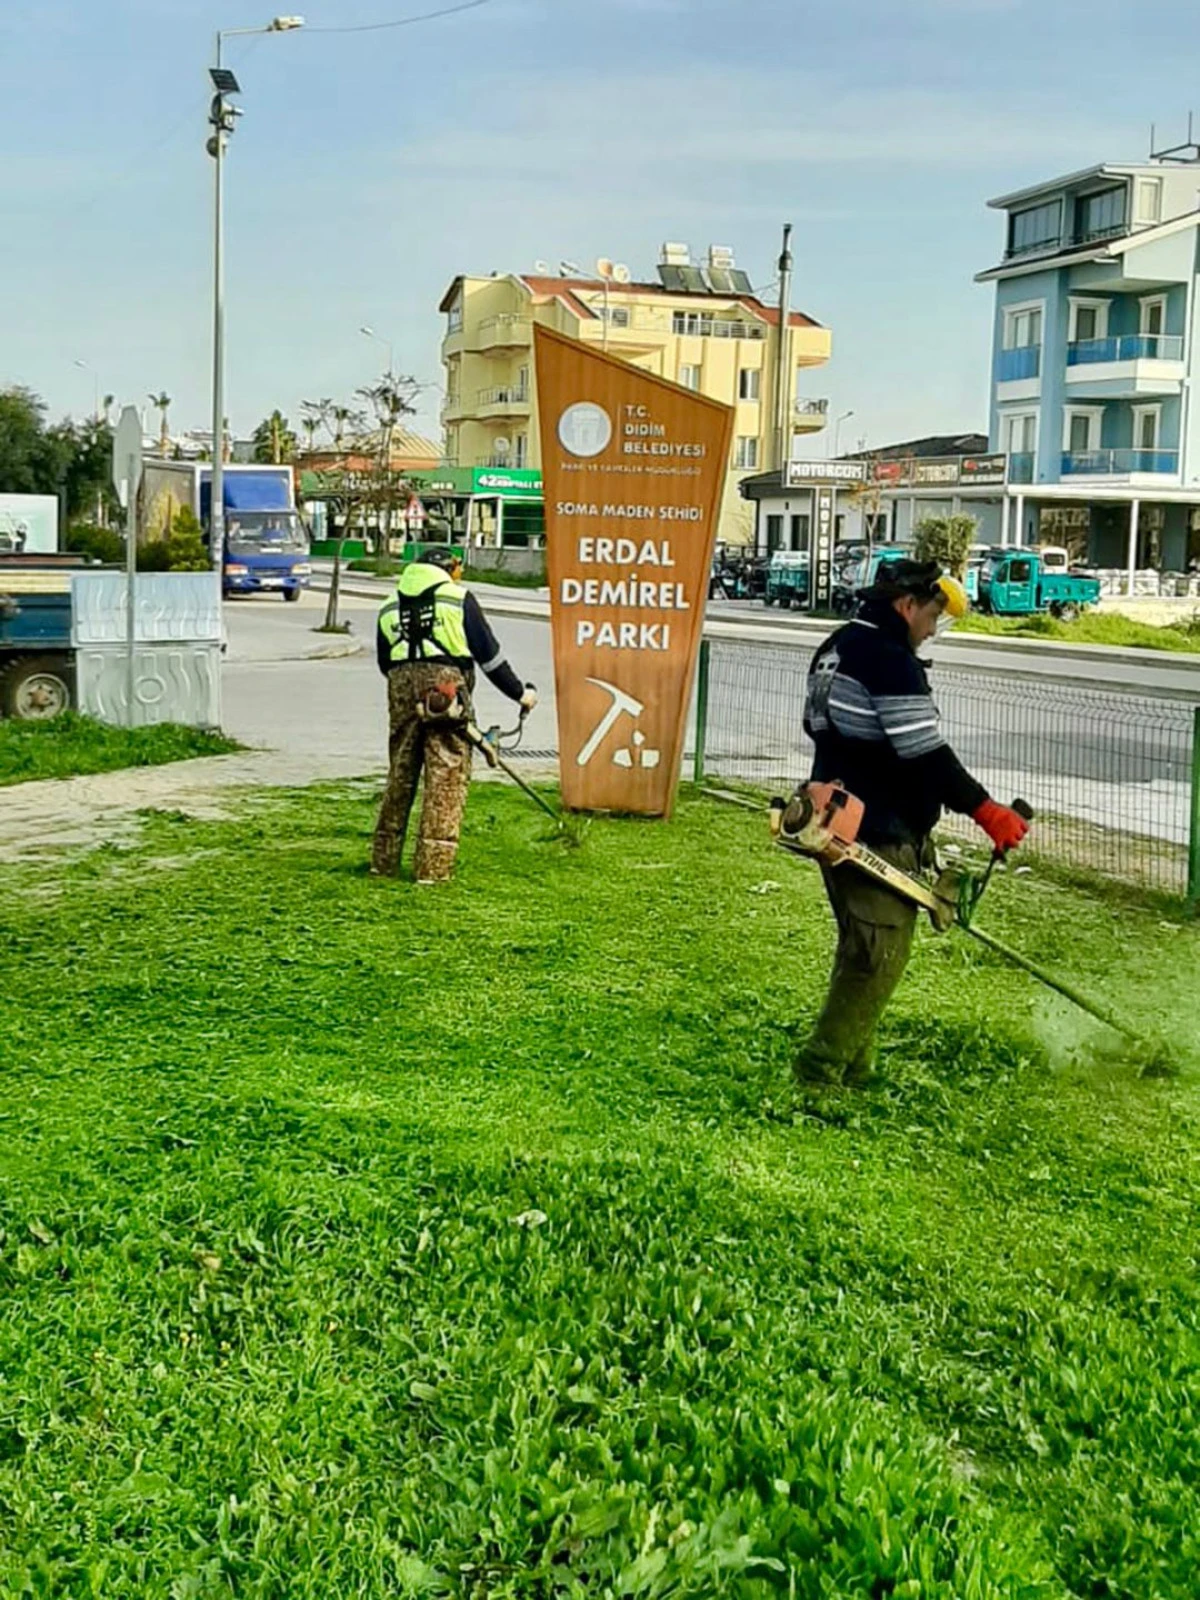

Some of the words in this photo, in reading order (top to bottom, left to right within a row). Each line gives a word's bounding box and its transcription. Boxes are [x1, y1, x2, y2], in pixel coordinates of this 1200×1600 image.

[626, 405, 651, 418] T.C.
[556, 501, 598, 516] SOMA
[602, 504, 655, 519] MADEN
[579, 537, 675, 566] ERDAL
[561, 573, 690, 609] DEMİREL
[577, 620, 670, 650] PARKI
